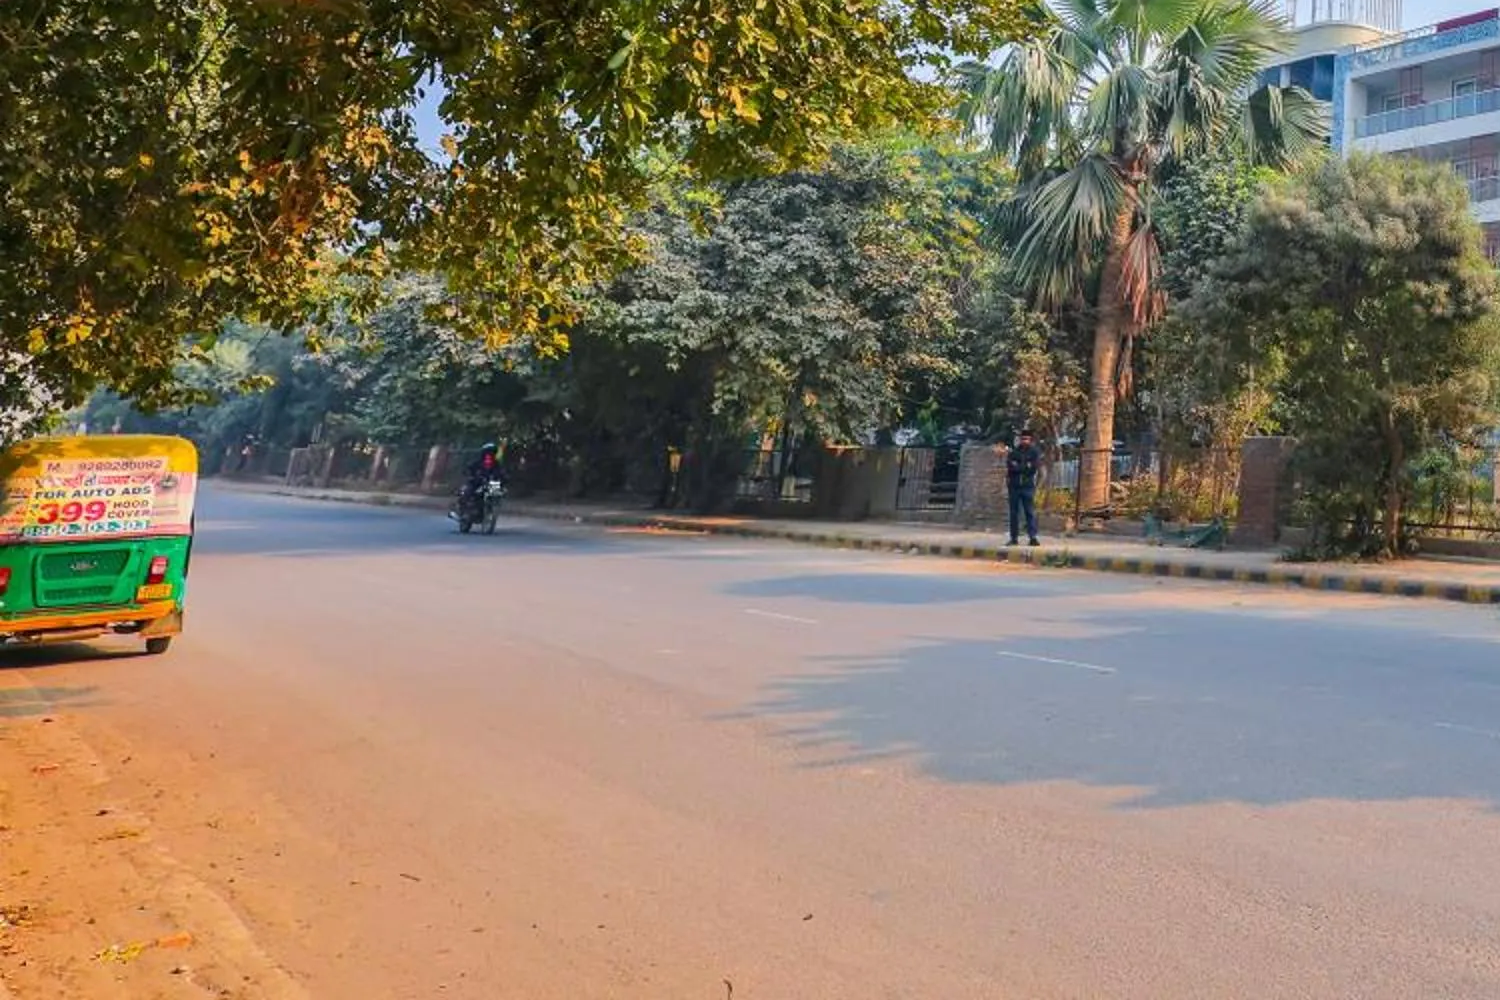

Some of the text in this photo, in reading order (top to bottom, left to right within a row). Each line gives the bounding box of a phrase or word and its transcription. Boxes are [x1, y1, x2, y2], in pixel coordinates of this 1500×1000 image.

[35, 490, 66, 499] FOR
[71, 486, 116, 498] AUTO
[121, 485, 152, 496] ADS
[37, 500, 107, 524] 399
[107, 509, 151, 519] COVER
